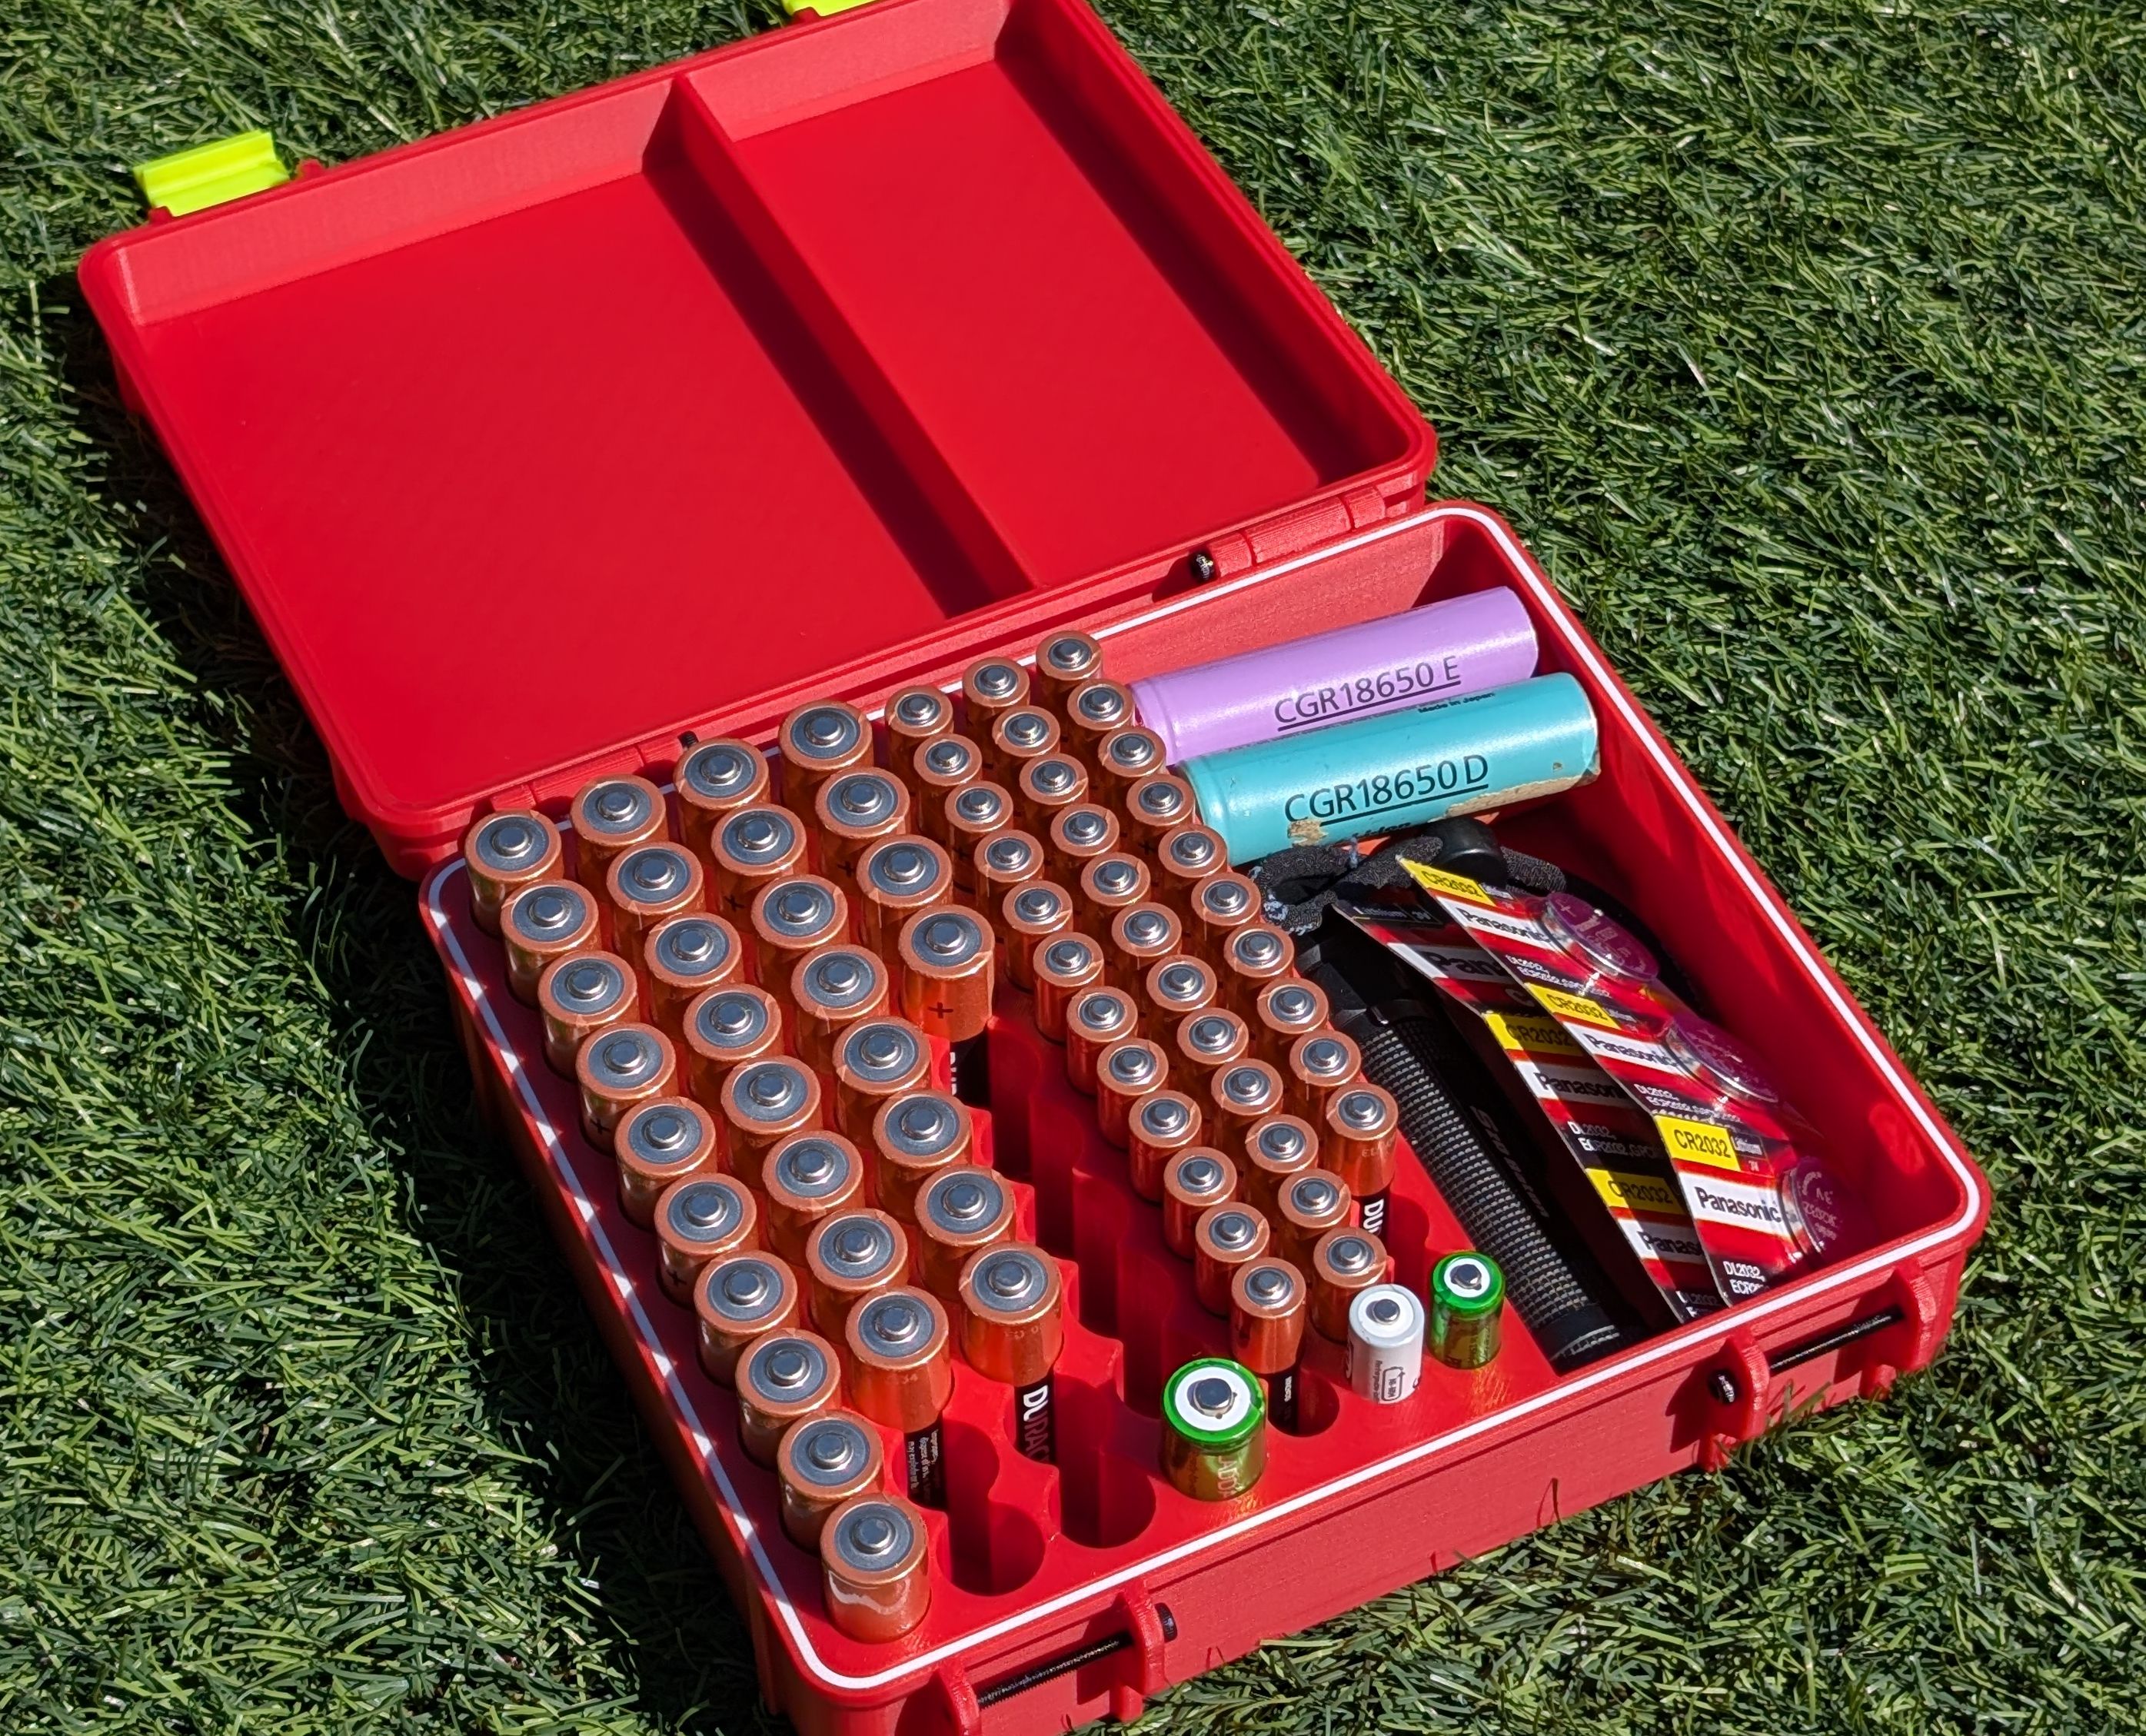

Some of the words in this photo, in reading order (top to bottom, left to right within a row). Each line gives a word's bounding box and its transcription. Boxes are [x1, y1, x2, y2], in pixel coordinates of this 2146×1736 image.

[1274, 661, 1435, 724] CGR18650
[1443, 655, 1461, 681] E
[1285, 760, 1458, 823] CGR18650
[1466, 754, 1489, 786] D
[1546, 994, 1609, 1021] CR2032
[1506, 1023, 1572, 1047] CR2032
[1583, 1033, 1681, 1069] Panasonic
[1673, 1129, 1732, 1159] CR2032
[1608, 1180, 1674, 1204] CR2032
[1693, 1186, 1783, 1224] Panasonic
[1363, 1198, 1384, 1236] DU
